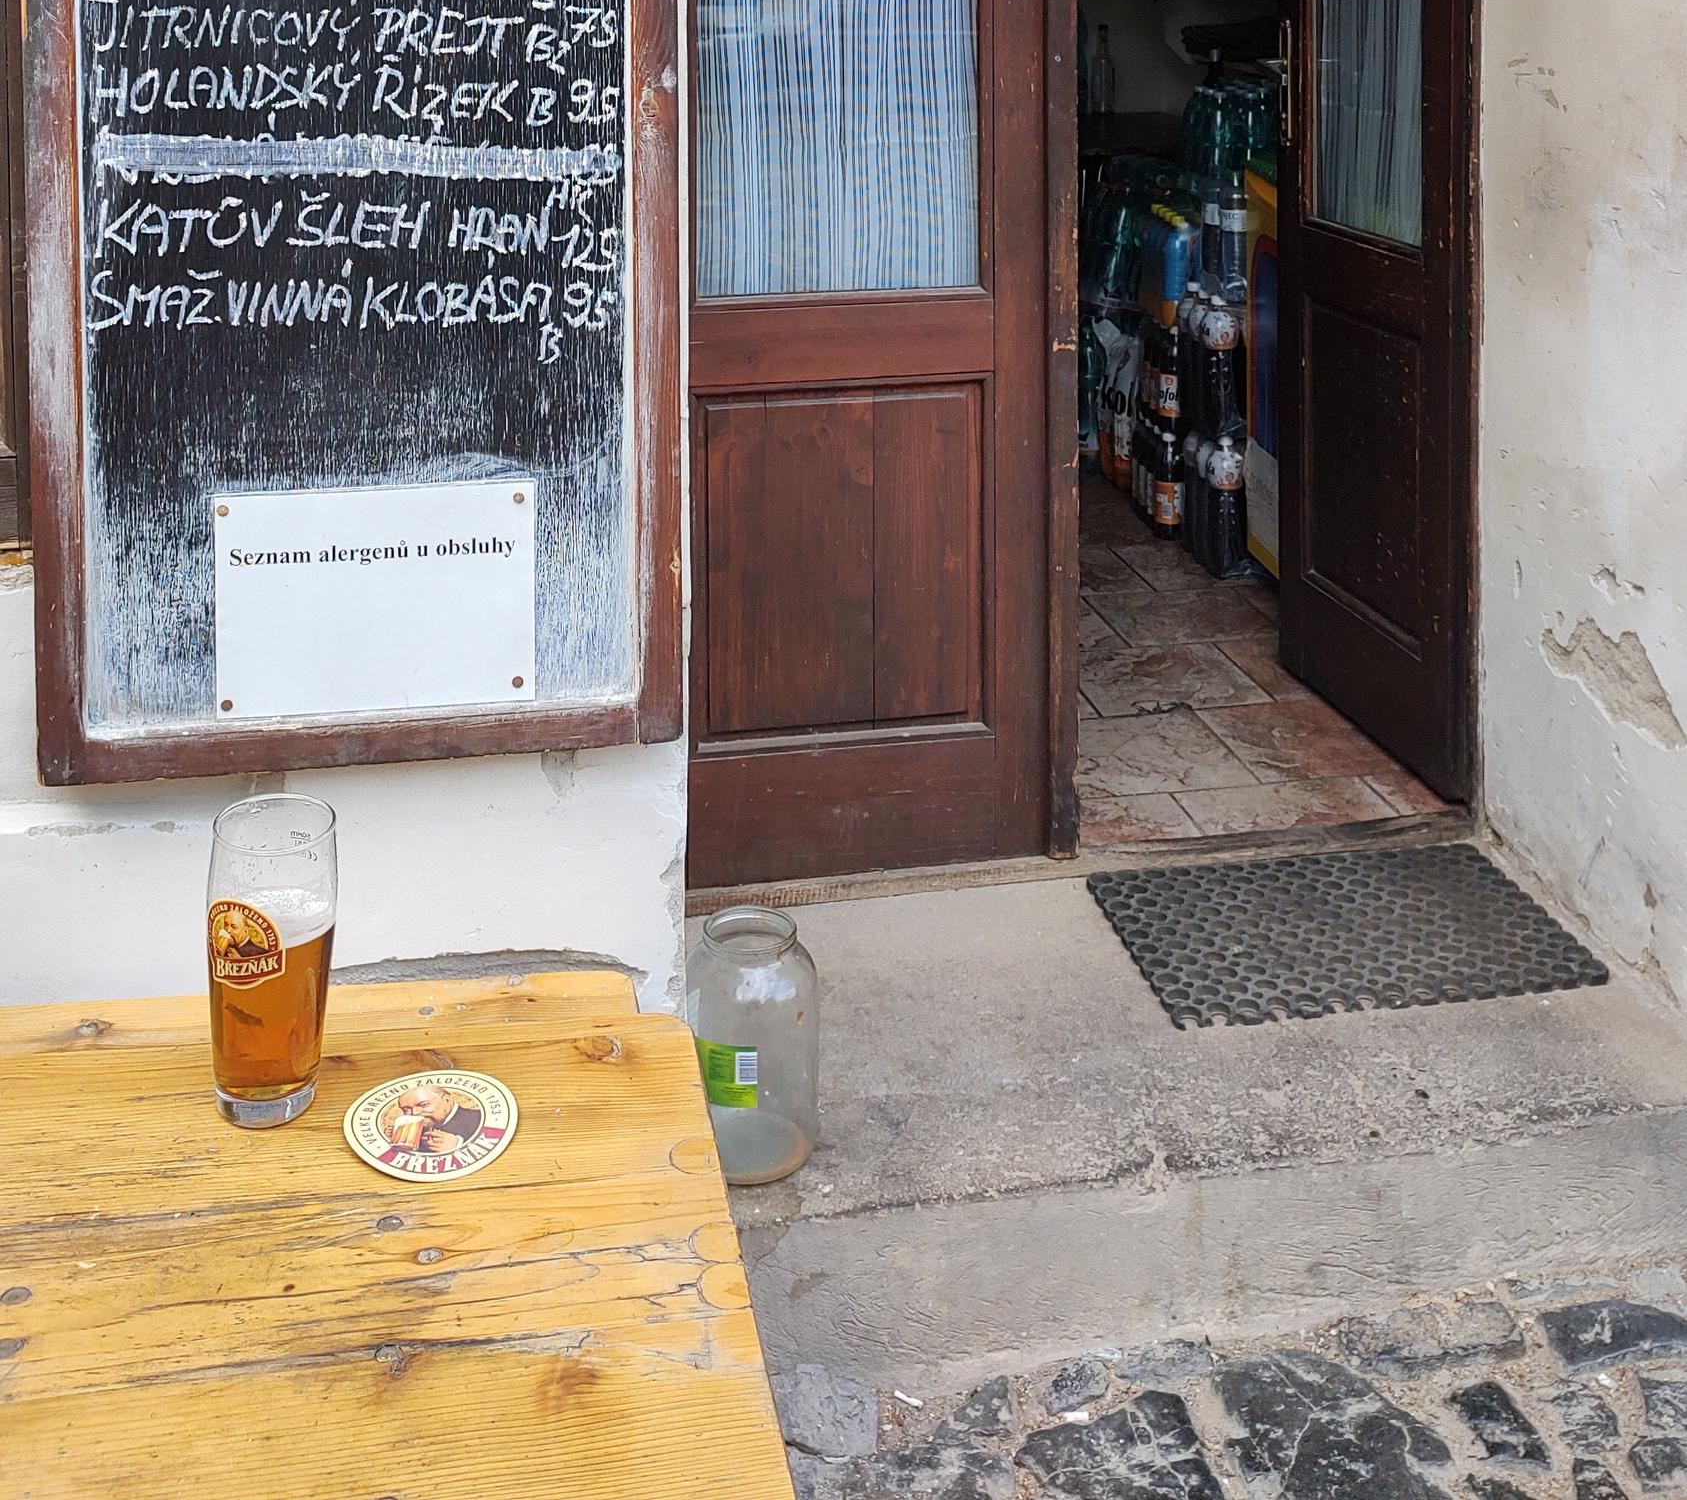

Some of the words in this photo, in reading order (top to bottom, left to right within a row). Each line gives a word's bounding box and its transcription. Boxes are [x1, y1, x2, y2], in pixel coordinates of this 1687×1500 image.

[370, 6, 525, 58] PREJT
[90, 50, 361, 122] HOLANDSKÝ
[372, 54, 519, 122] ŘÍZEK
[526, 86, 556, 127] B
[286, 189, 431, 250] ŠLEH
[448, 204, 550, 256] HRAN
[227, 258, 352, 328] VINNÁ
[360, 250, 552, 330] KLOBÁSA
[229, 548, 311, 567] Seznam
[318, 540, 409, 566] alergenů
[416, 544, 429, 557] u
[436, 537, 516, 558] obsluhy
